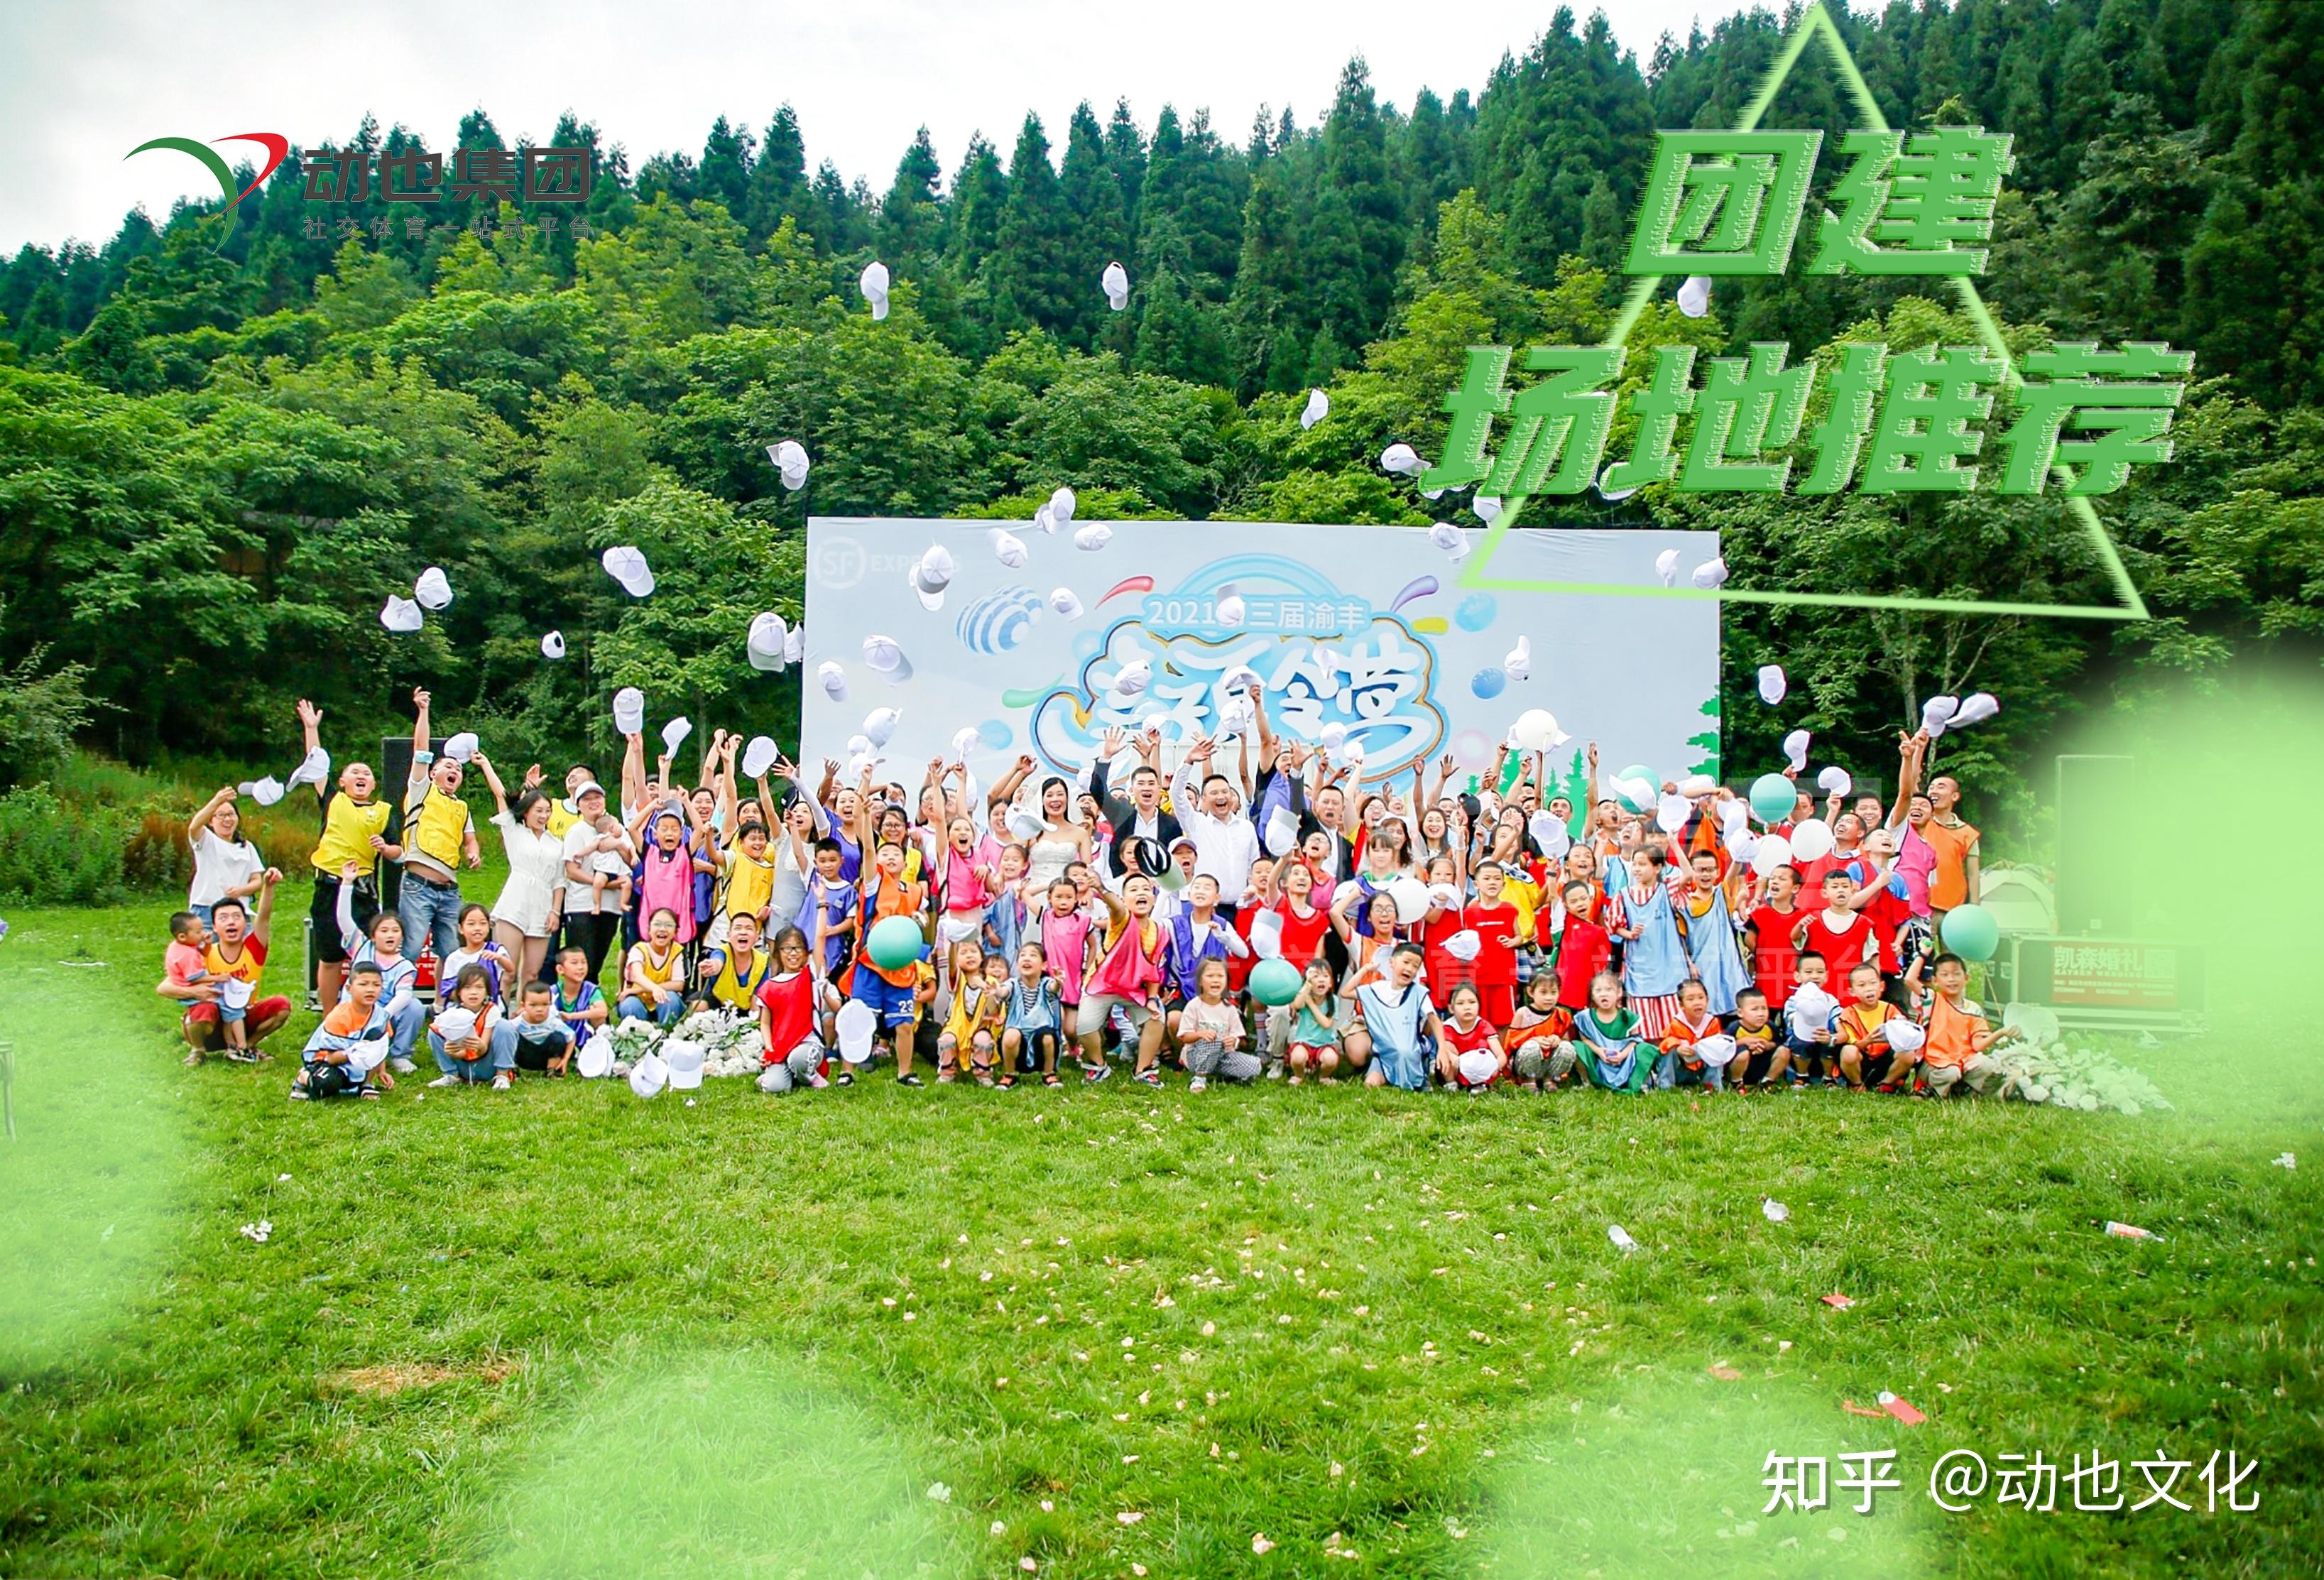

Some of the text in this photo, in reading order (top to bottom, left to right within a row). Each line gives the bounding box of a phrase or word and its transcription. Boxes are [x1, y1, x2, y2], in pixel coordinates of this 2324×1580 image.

[1148, 601, 1365, 630] 2021三届渝丰
[2053, 946, 2143, 971] 凯森婚礼
[898, 999, 914, 1013] 23
